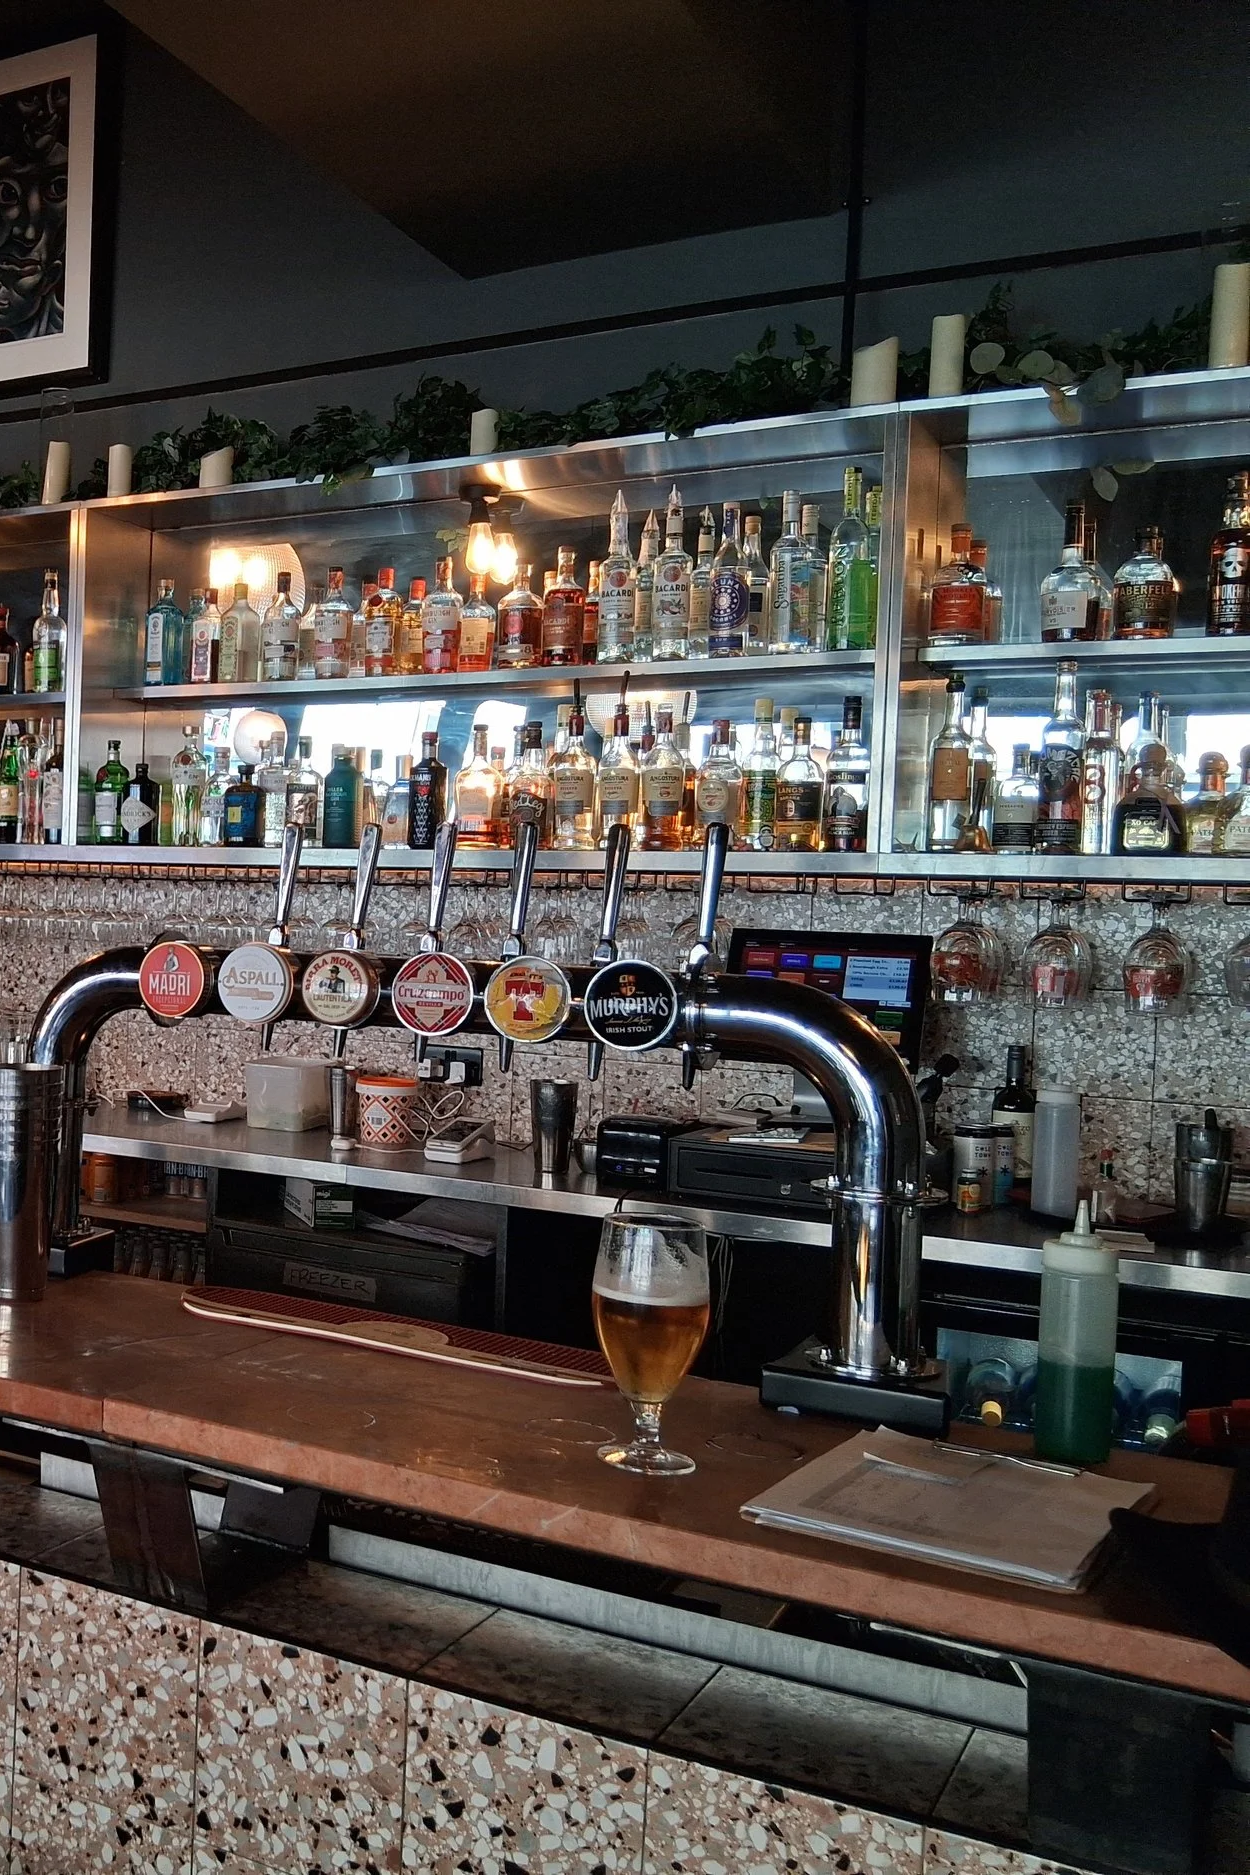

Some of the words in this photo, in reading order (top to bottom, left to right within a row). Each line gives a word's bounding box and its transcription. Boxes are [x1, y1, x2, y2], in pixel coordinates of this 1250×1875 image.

[774, 560, 790, 609] Sagatiba
[778, 786, 804, 794] LANGS
[222, 966, 280, 989] ASPALL
[398, 985, 465, 1003] Cruzcampo
[589, 992, 669, 1020] MURPHY'S
[605, 1025, 626, 1033] IRISH
[626, 1025, 653, 1033] STOUT
[289, 1268, 371, 1296] FREEZER
